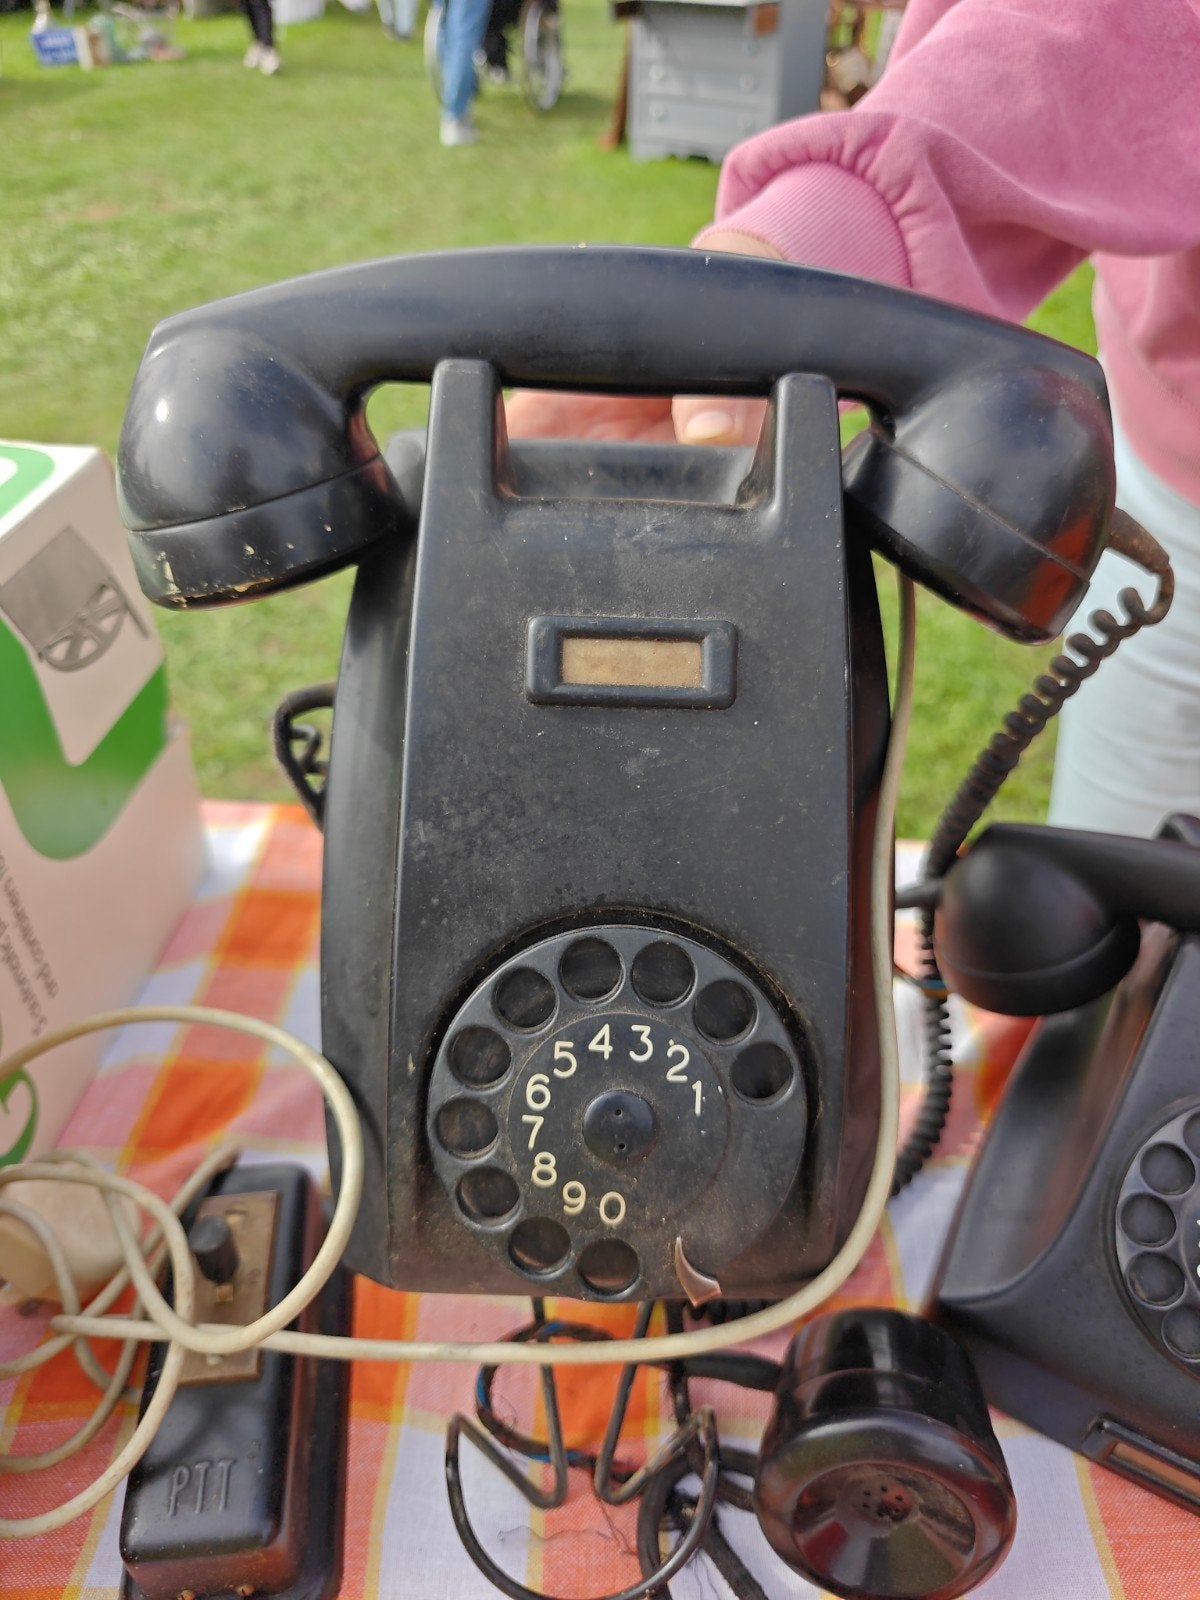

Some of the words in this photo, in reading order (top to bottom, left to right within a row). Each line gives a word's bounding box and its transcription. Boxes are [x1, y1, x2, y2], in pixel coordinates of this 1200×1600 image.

[552, 1040, 578, 1079] 5
[587, 1023, 614, 1061] 4
[628, 1024, 654, 1063] 3
[665, 1044, 690, 1083] 2
[525, 1072, 552, 1112] 6
[691, 1079, 703, 1117] 1
[521, 1114, 545, 1151] 7
[530, 1151, 558, 1188] 8
[562, 1180, 587, 1215] 9
[168, 1459, 237, 1517] PTT
